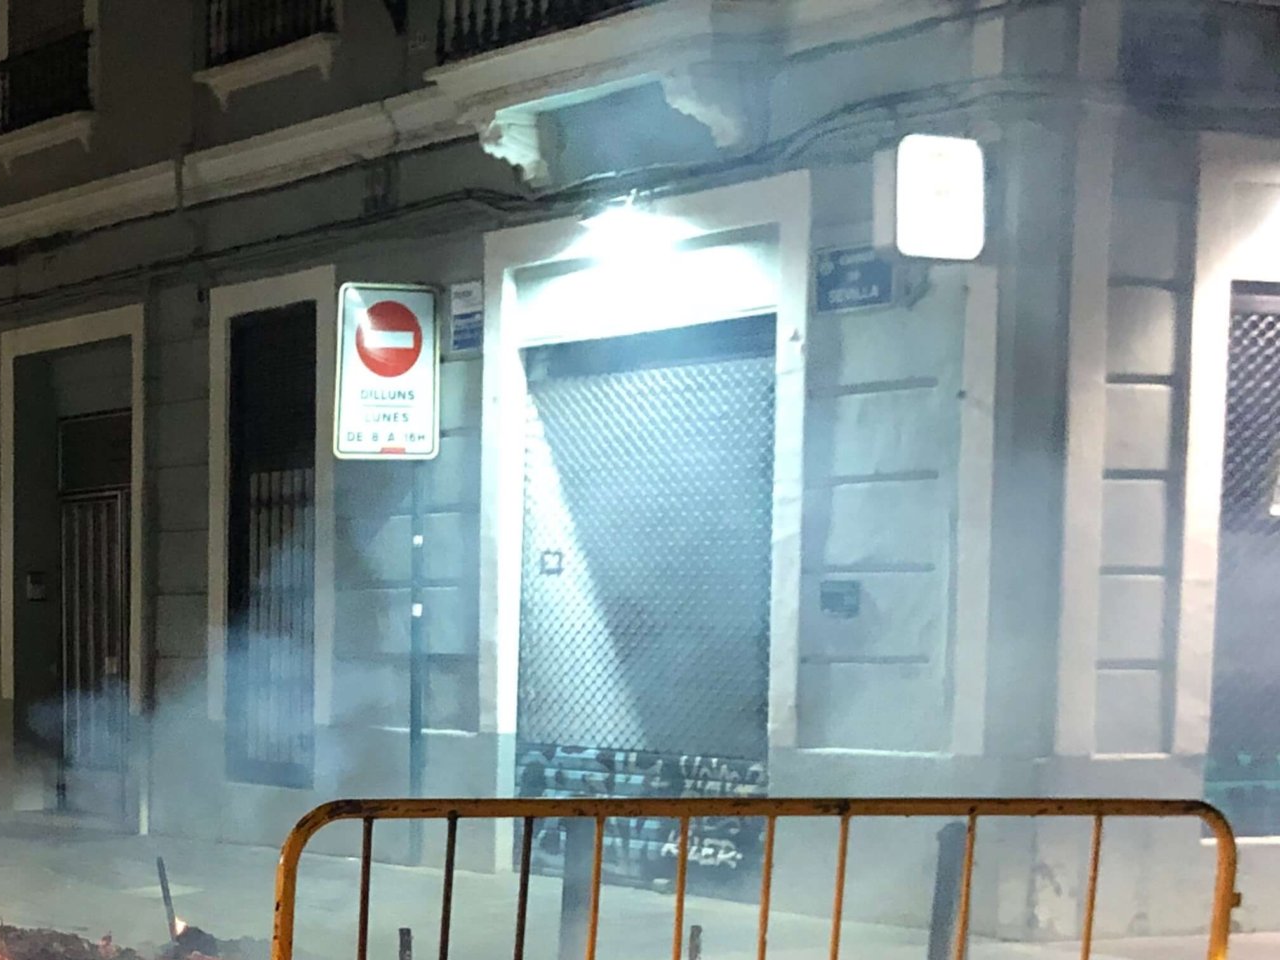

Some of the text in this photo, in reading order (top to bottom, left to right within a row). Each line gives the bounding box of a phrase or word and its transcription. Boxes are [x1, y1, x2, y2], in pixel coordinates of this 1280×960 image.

[360, 388, 415, 400] DILLUNS
[365, 411, 409, 423] LUNES
[346, 431, 363, 442] DE
[371, 431, 379, 442] 8
[387, 431, 395, 442] A
